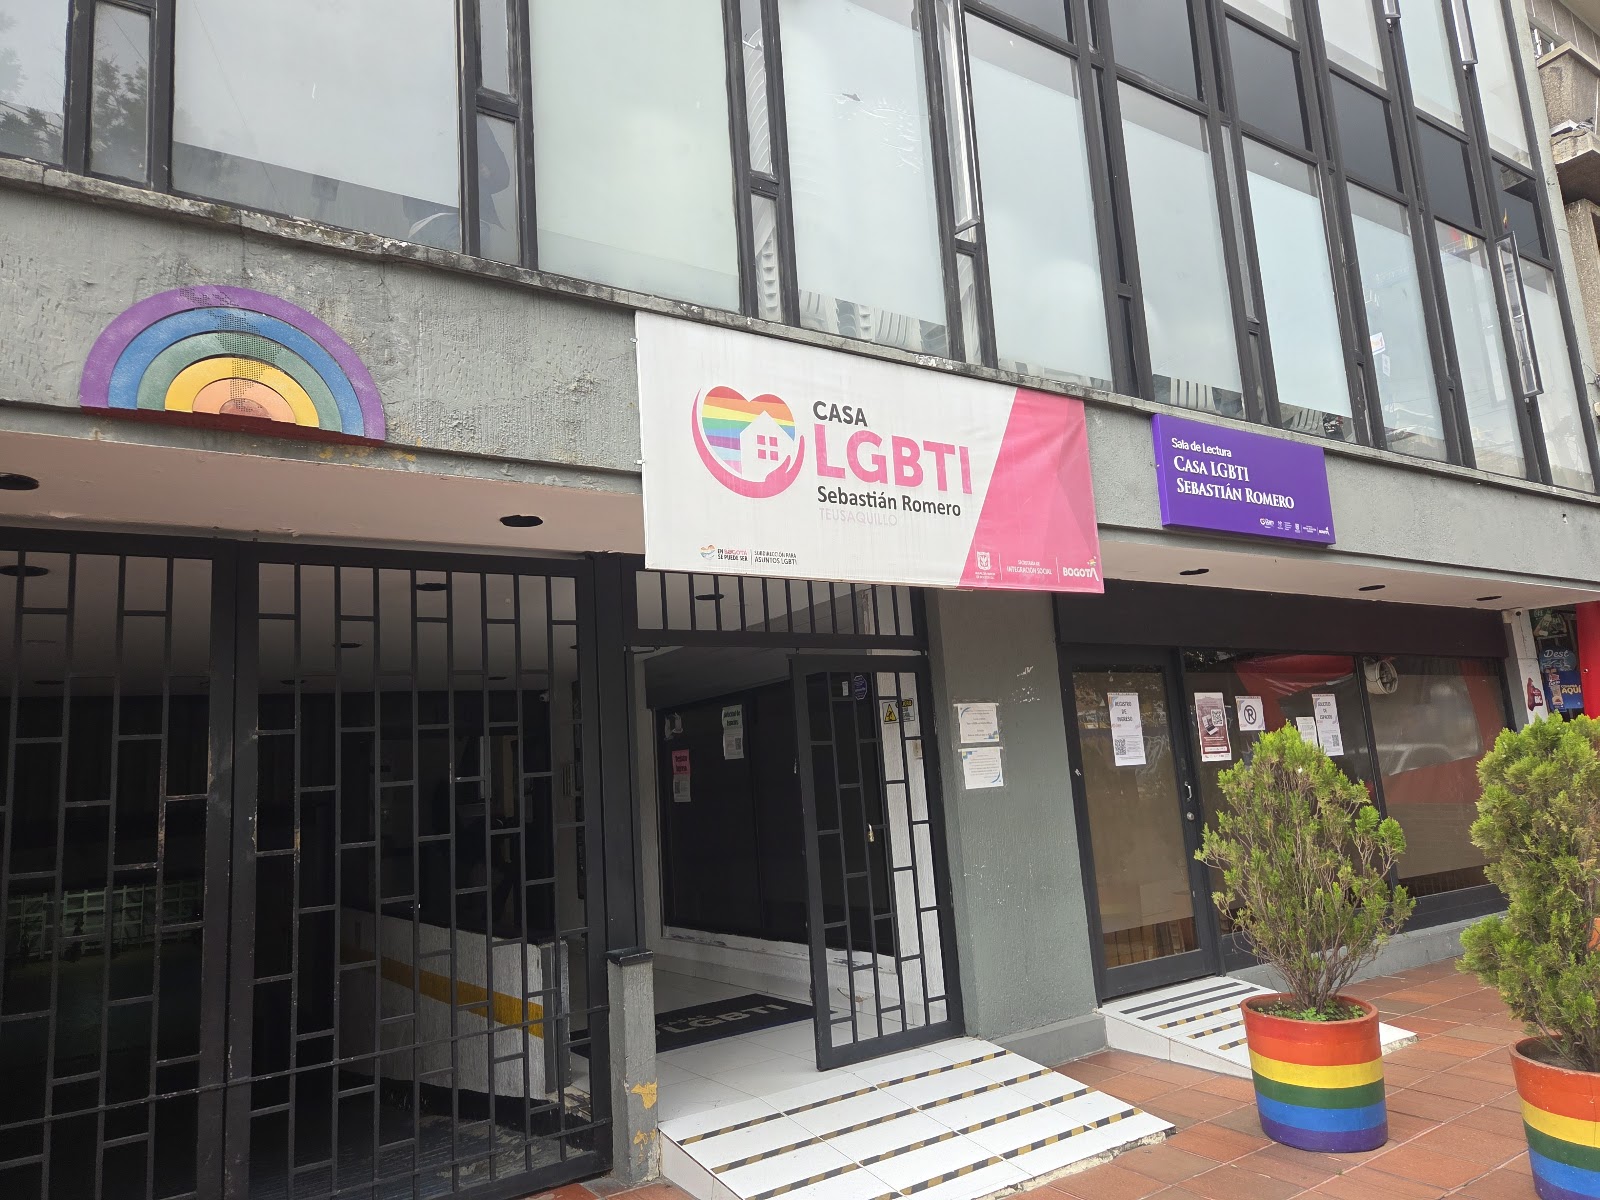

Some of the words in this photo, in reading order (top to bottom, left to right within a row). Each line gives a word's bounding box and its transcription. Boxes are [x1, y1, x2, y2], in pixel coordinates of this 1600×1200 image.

[813, 401, 868, 427] CASA
[814, 423, 972, 495] LGBTI
[1171, 437, 1190, 450] Sala
[1190, 441, 1201, 452] de
[1203, 443, 1232, 458] Lectura
[1173, 455, 1208, 475] CASA
[1210, 461, 1250, 482] LGBTI
[817, 485, 897, 510] Sebastián
[902, 494, 961, 517] Romero
[1176, 478, 1242, 502] SEBASTIÁN
[1246, 488, 1295, 509] ROMERO
[818, 507, 897, 527] TEUSAQUILLO
[754, 556, 781, 564] ASUNTOS
[1037, 567, 1052, 575] SOCIAL
